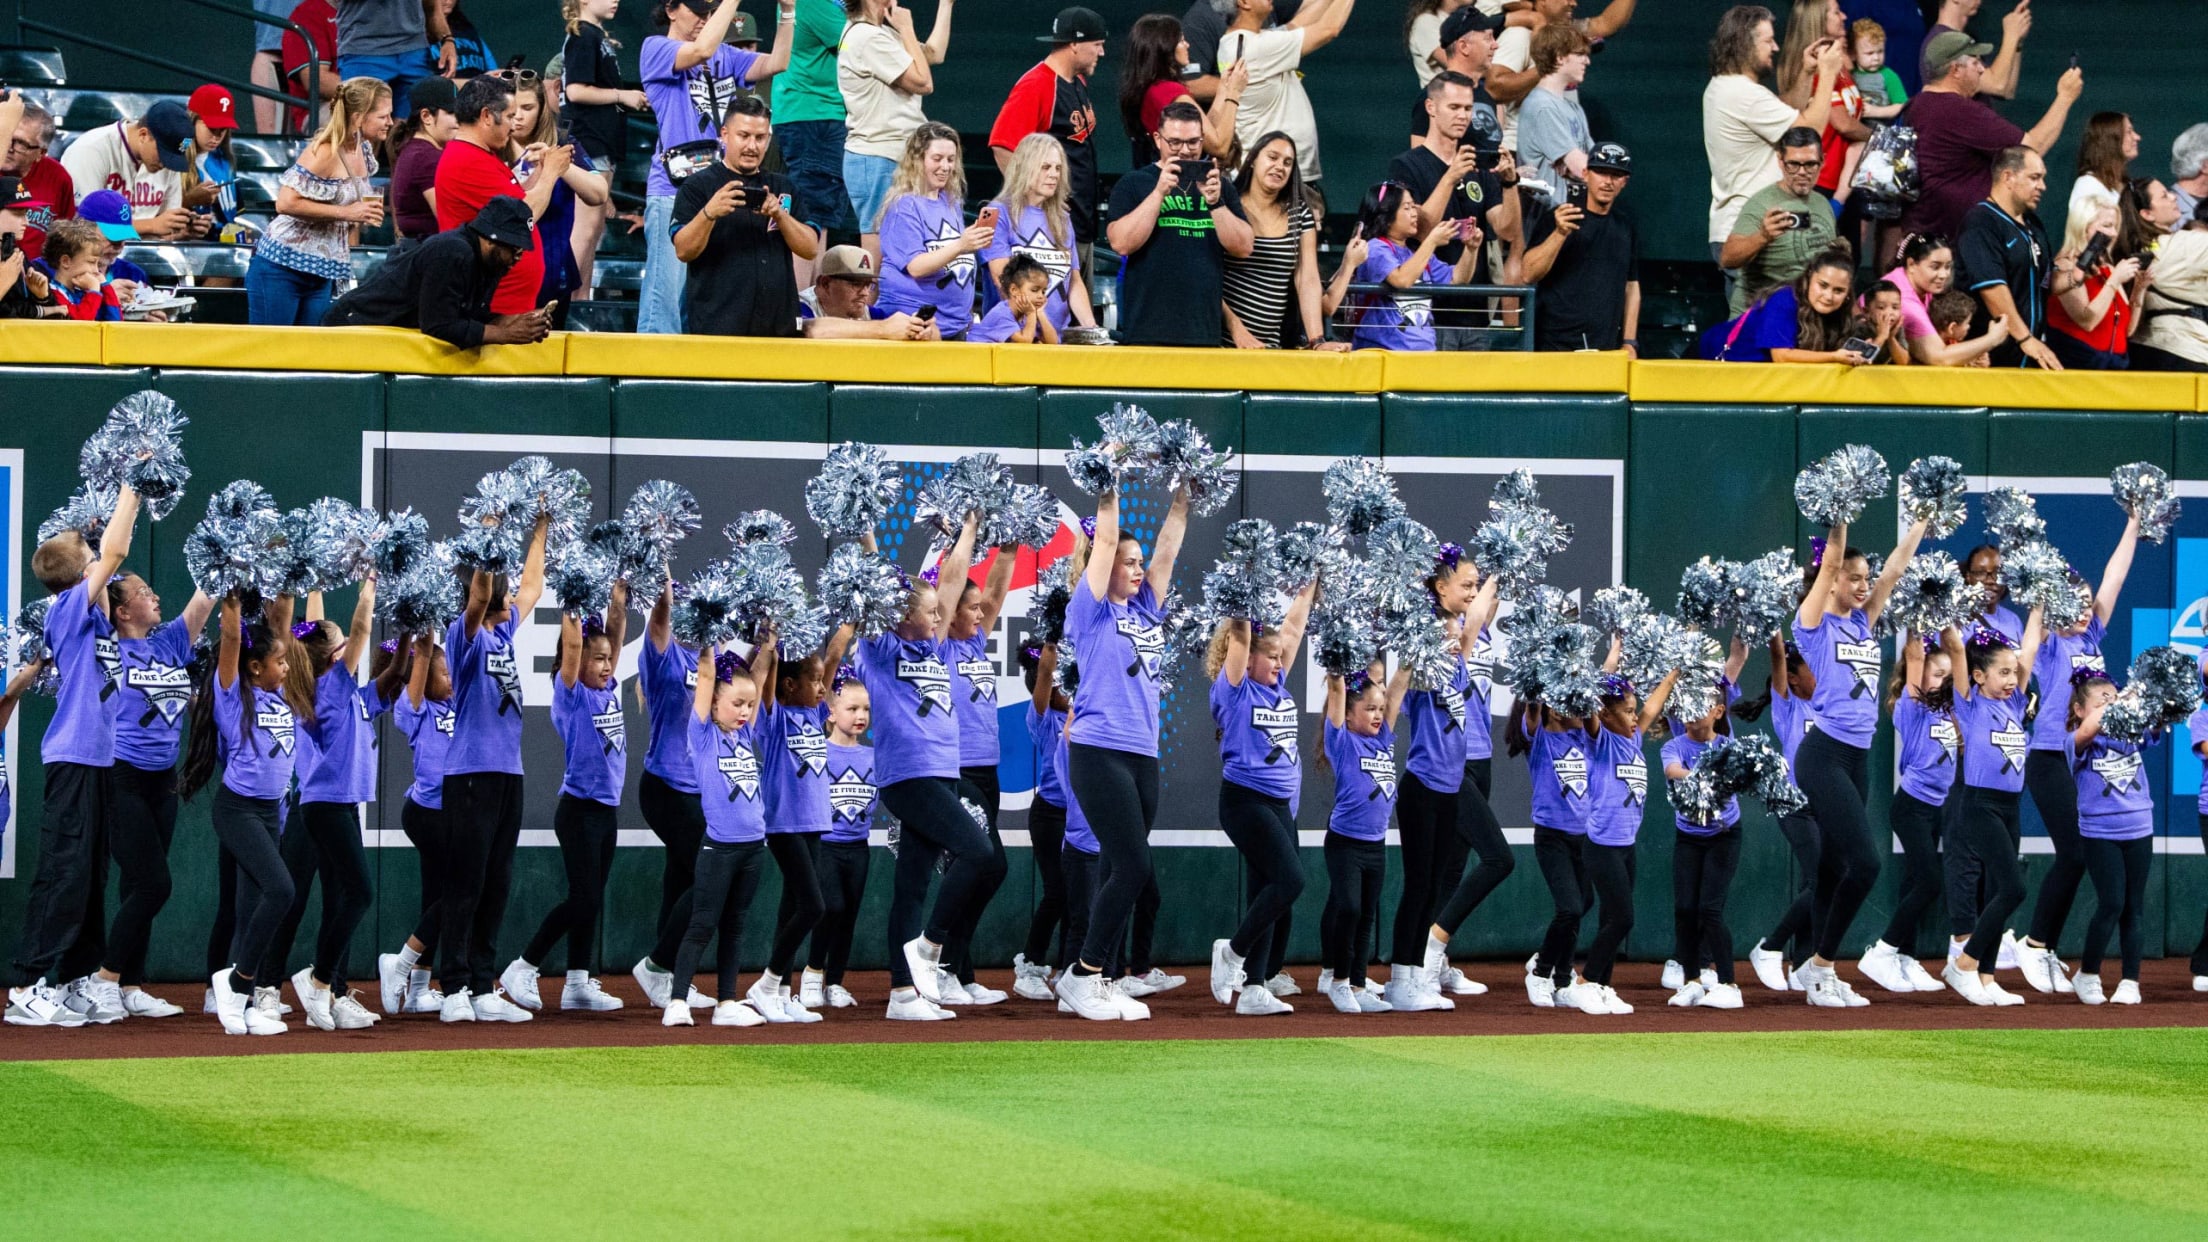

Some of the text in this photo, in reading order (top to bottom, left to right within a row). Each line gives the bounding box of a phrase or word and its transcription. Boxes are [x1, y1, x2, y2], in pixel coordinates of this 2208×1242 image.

[220, 97, 230, 112] P
[1160, 195, 1194, 213] ANCE
[858, 254, 871, 270] A
[901, 665, 928, 673] TAKE
[131, 673, 158, 681] TAKE
[1255, 713, 1281, 722] TAKE
